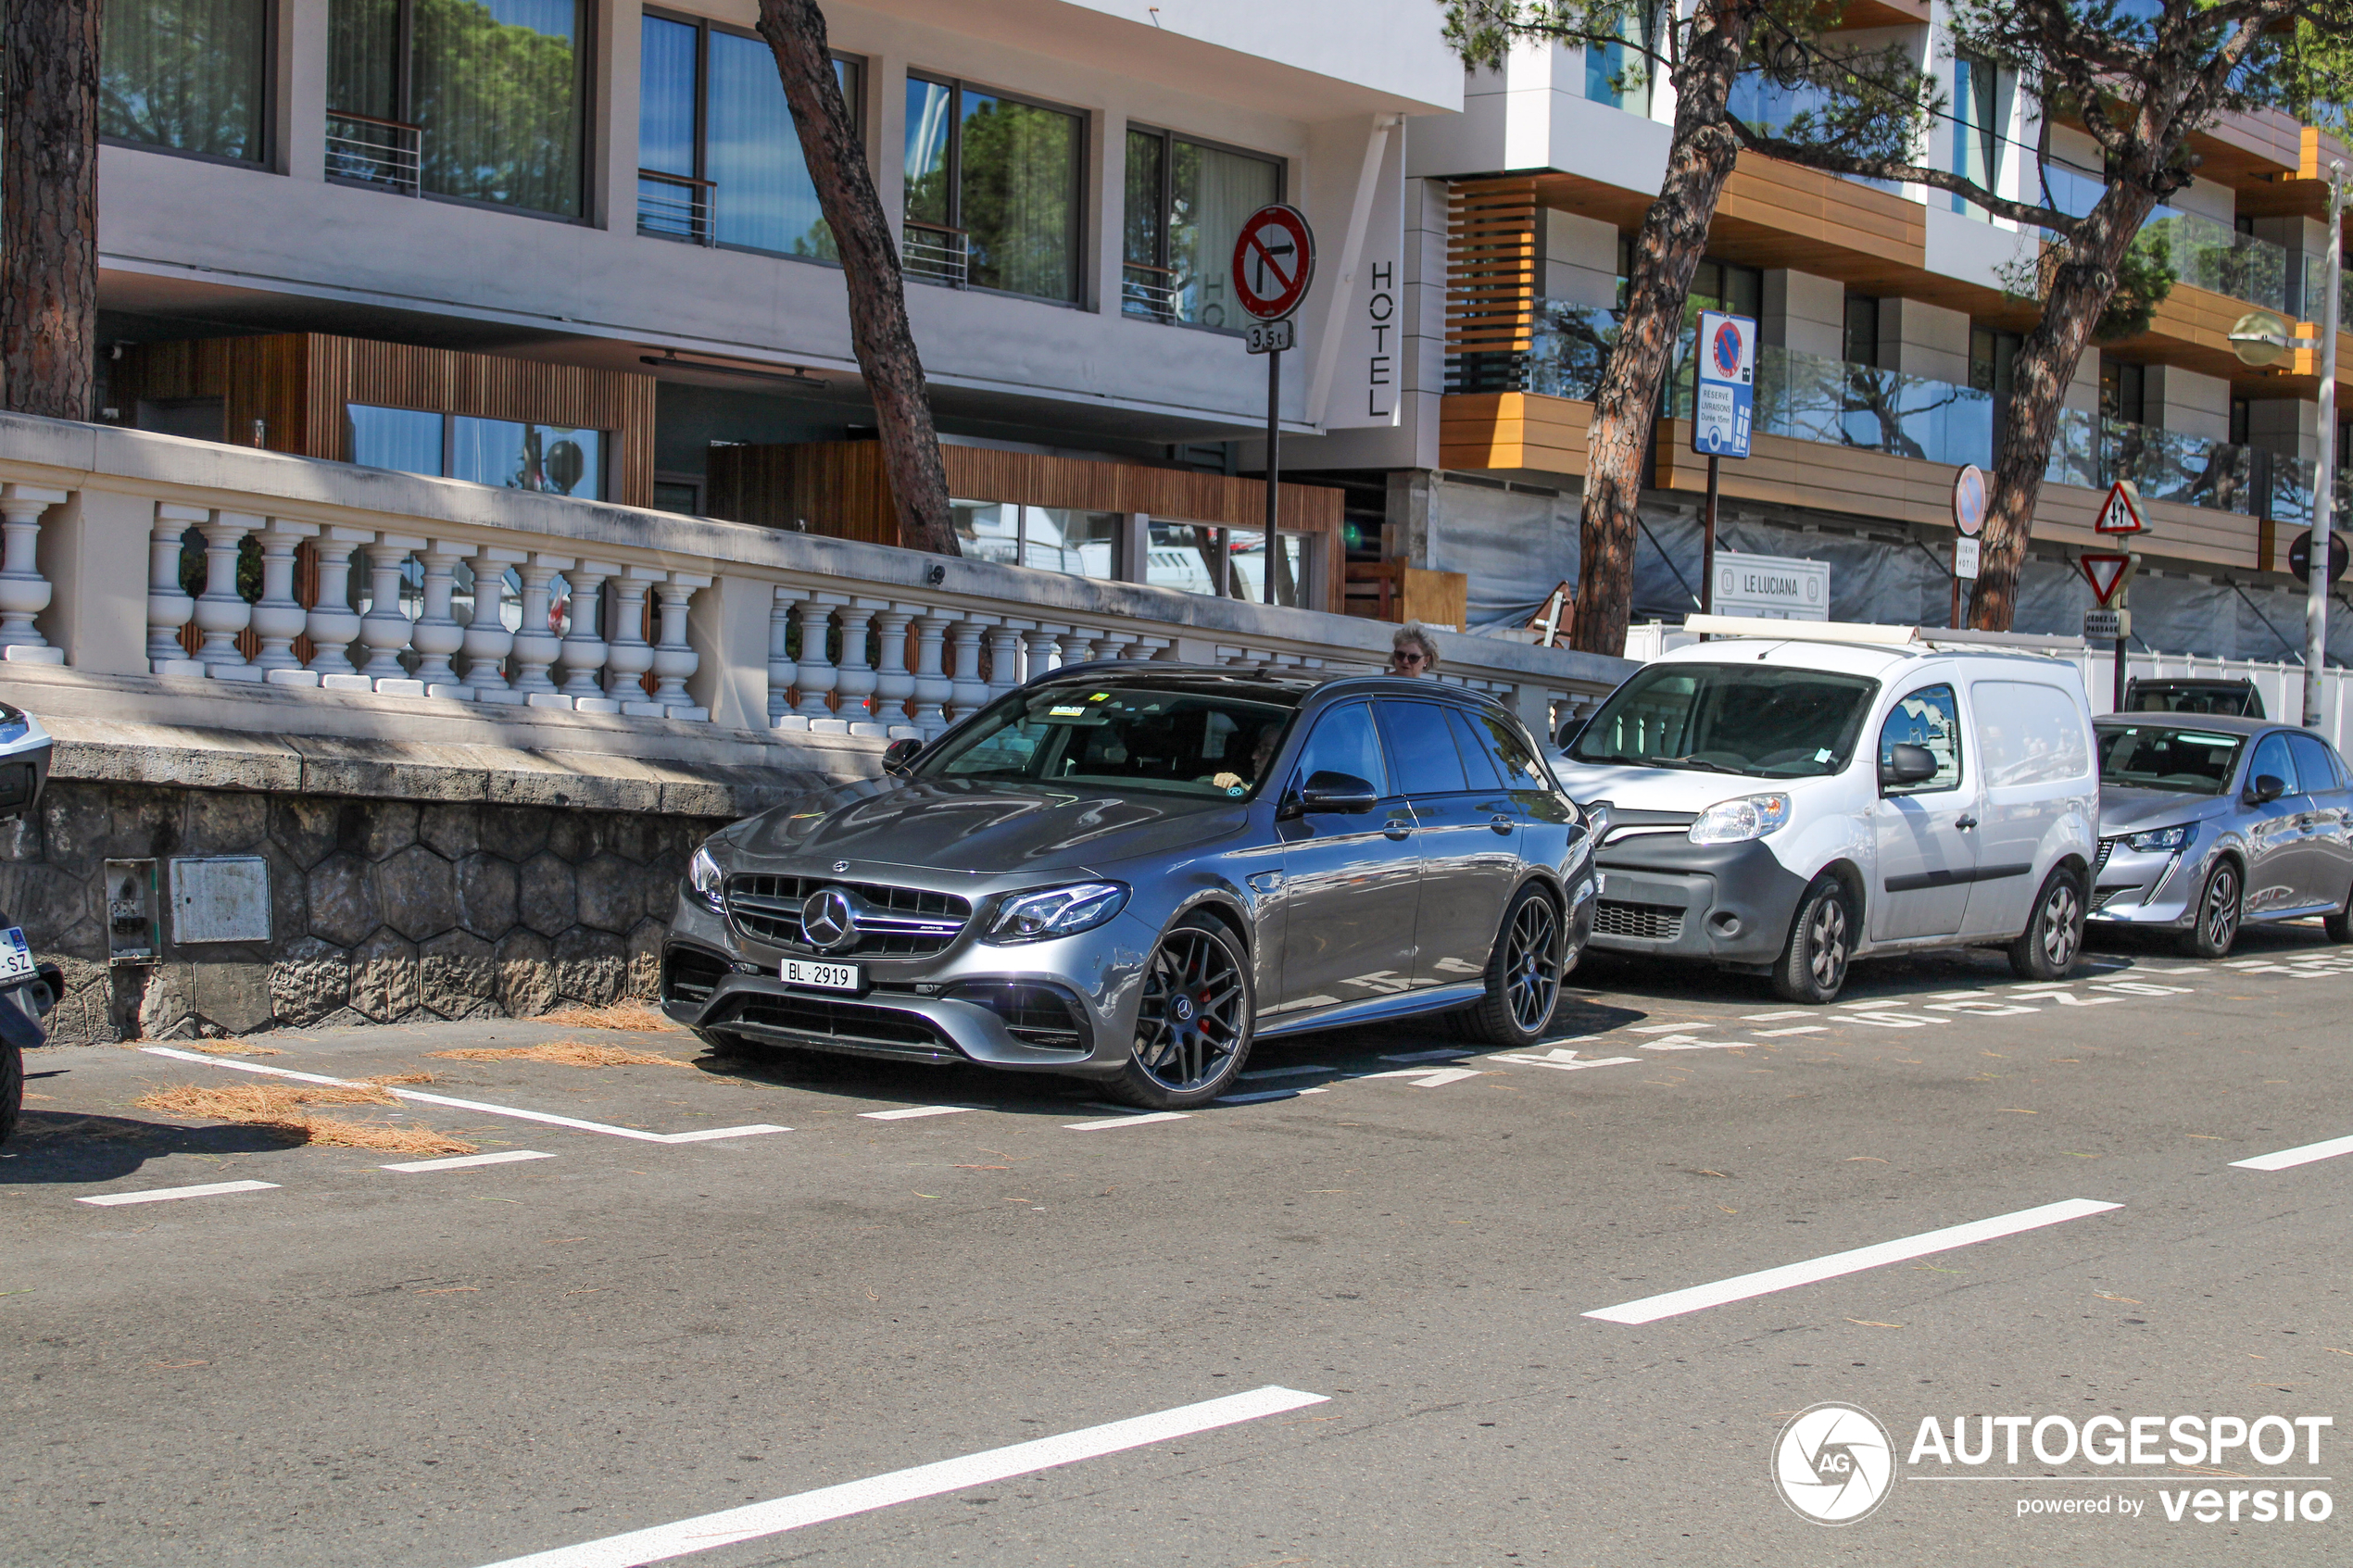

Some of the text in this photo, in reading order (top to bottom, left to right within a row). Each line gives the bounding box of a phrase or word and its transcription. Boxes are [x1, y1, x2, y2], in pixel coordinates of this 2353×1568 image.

[1369, 261, 1393, 417] HOTEL
[1701, 401, 1731, 414] LIVRAISONS
[1701, 412, 1716, 422] Durée
[1744, 574, 1798, 596] LE LUCIANA
[2086, 625, 2118, 633] PASSAGE
[814, 965, 849, 986] 2919
